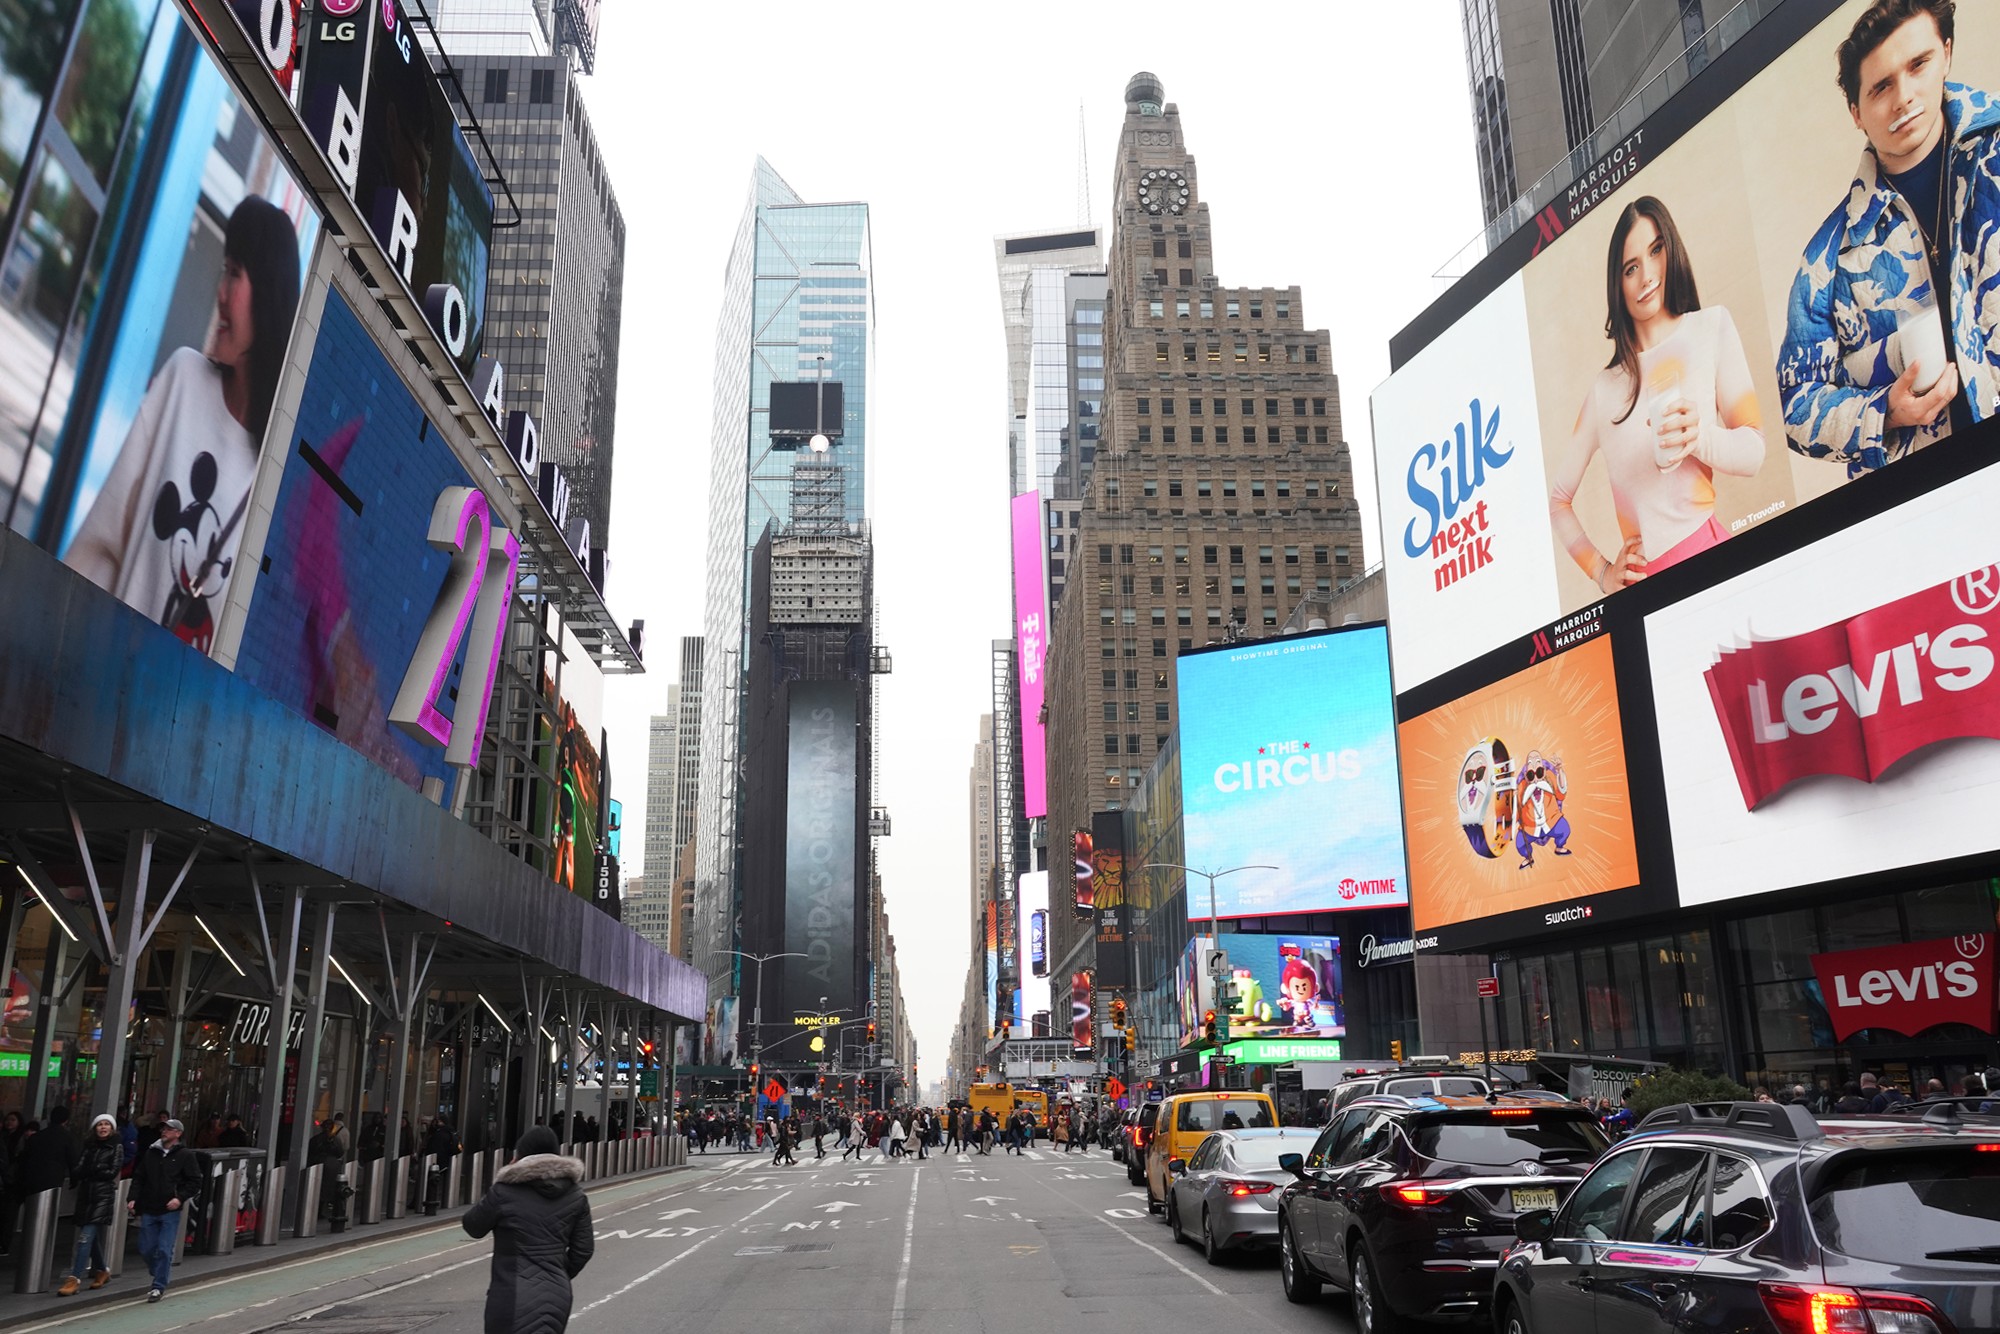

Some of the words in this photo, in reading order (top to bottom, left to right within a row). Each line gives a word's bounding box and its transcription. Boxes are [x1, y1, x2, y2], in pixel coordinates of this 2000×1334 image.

[320, 22, 356, 42] LG
[395, 19, 411, 64] LG
[1568, 129, 1643, 202] MARRIOTT
[1570, 156, 1637, 220] MARQUIS
[1404, 398, 1515, 558] Silk
[1431, 500, 1489, 560] next
[1731, 518, 1748, 531] Ella
[1746, 500, 1786, 523] Travolta
[1434, 536, 1494, 592] milk
[397, 487, 521, 769] 21
[1553, 604, 1605, 635] MARRIOTT
[1555, 621, 1600, 649] MARQUIS
[1231, 649, 1279, 662] SHOWTIME
[1283, 642, 1329, 655] ORIGINAL
[1267, 740, 1300, 756] THE
[809, 706, 835, 865] ORIGINALS
[1214, 748, 1362, 793] CIRCUS
[598, 856, 609, 899] 1500
[1338, 878, 1397, 900] SHOWTIME
[807, 871, 832, 984] ADIDAS
[1101, 918, 1118, 926] SHOW
[1104, 910, 1115, 918] THE
[1545, 906, 1585, 925] swatch
[1097, 934, 1123, 942] LIFETIME
[1104, 926, 1112, 934] OF
[1358, 934, 1414, 968] Paramoun
[1137, 1060, 1149, 1068] 25
[1260, 1045, 1288, 1057] LINE
[593, 1225, 722, 1240] NLY
